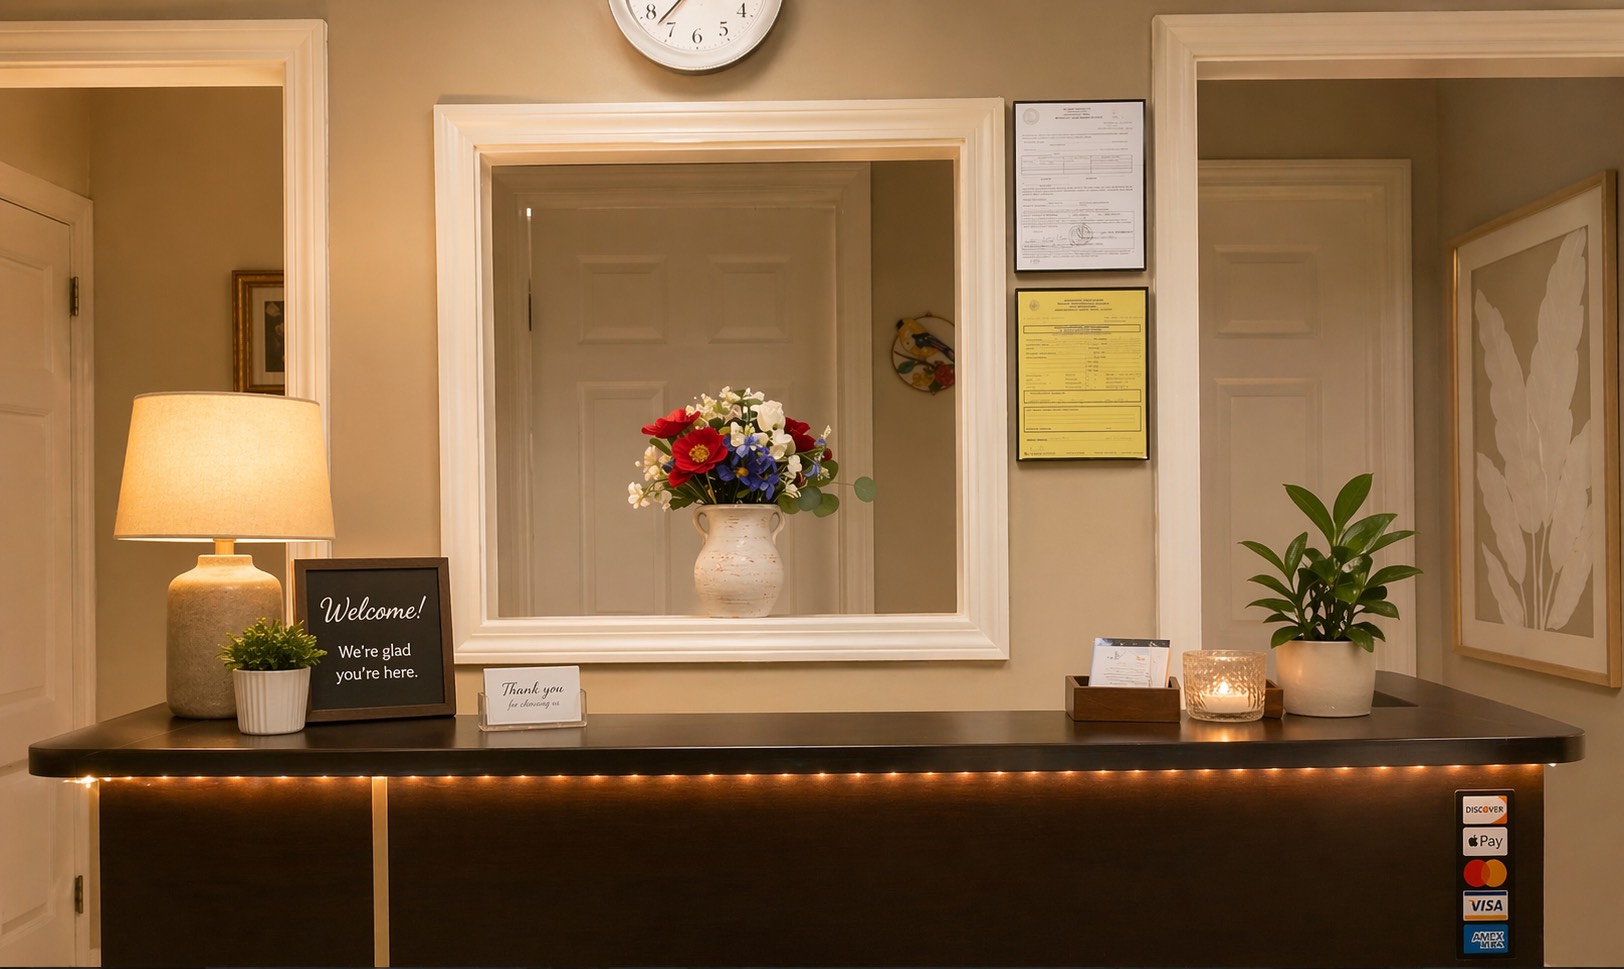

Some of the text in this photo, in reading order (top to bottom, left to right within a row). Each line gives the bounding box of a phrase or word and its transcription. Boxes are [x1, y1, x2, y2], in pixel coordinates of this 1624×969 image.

[646, 4, 657, 20] 8
[737, 3, 747, 18] 4
[666, 22, 676, 38] 7
[692, 28, 703, 44] 6
[719, 21, 729, 37] 5
[319, 594, 427, 624] Welcome!
[338, 642, 412, 661] We're glad
[335, 666, 419, 685] you're here.
[501, 680, 565, 699] Thank you
[507, 699, 519, 711] for
[1465, 805, 1504, 814] DISCOVER
[1479, 835, 1503, 850] Pay
[1469, 899, 1503, 912] VISA
[1471, 931, 1505, 943] AMEX
